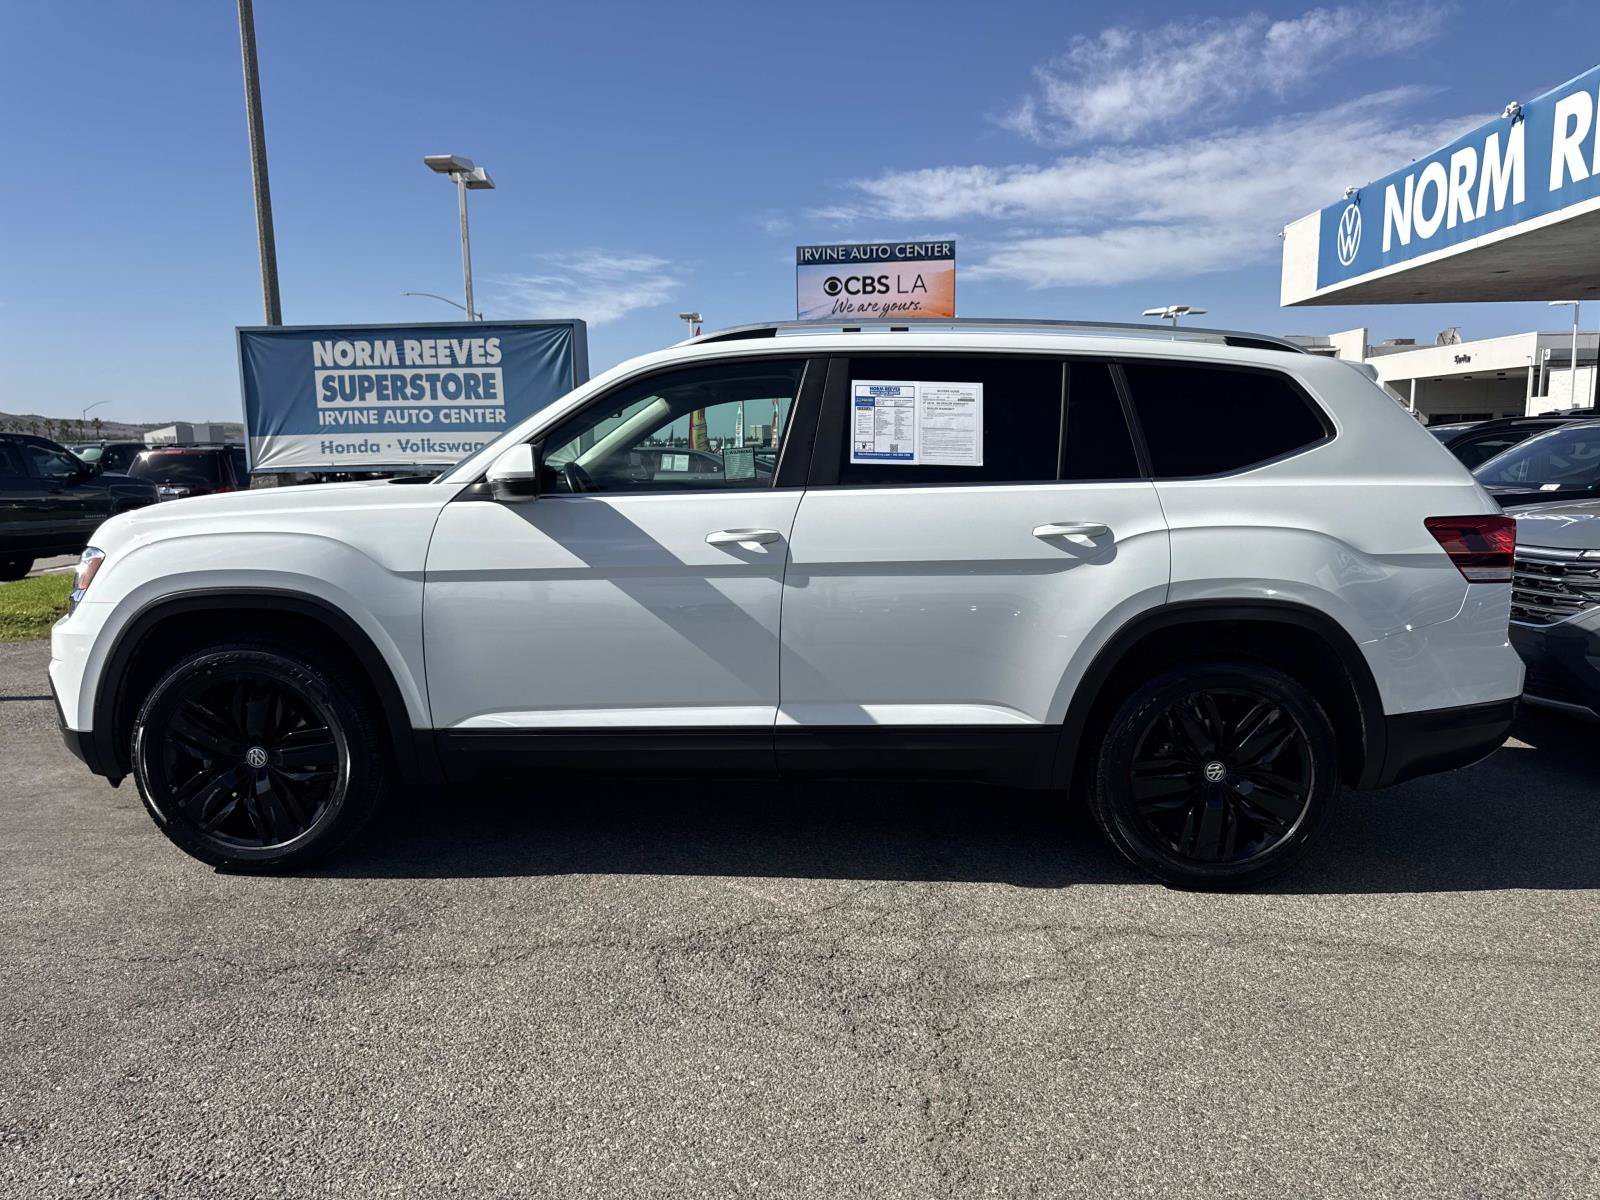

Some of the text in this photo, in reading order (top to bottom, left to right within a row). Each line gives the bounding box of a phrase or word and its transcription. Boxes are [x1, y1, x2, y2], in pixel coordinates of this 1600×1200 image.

[1382, 82, 1600, 253] NORM R
[800, 243, 951, 261] IRVINE AUTO CENTER
[844, 274, 928, 295] CBS LA
[831, 298, 922, 318] We are yours.
[312, 337, 502, 367] NORM REEVES
[321, 372, 498, 402] SUPERSTORE
[318, 408, 507, 426] IRVINE AUTO CENTER
[320, 439, 381, 455] Honda
